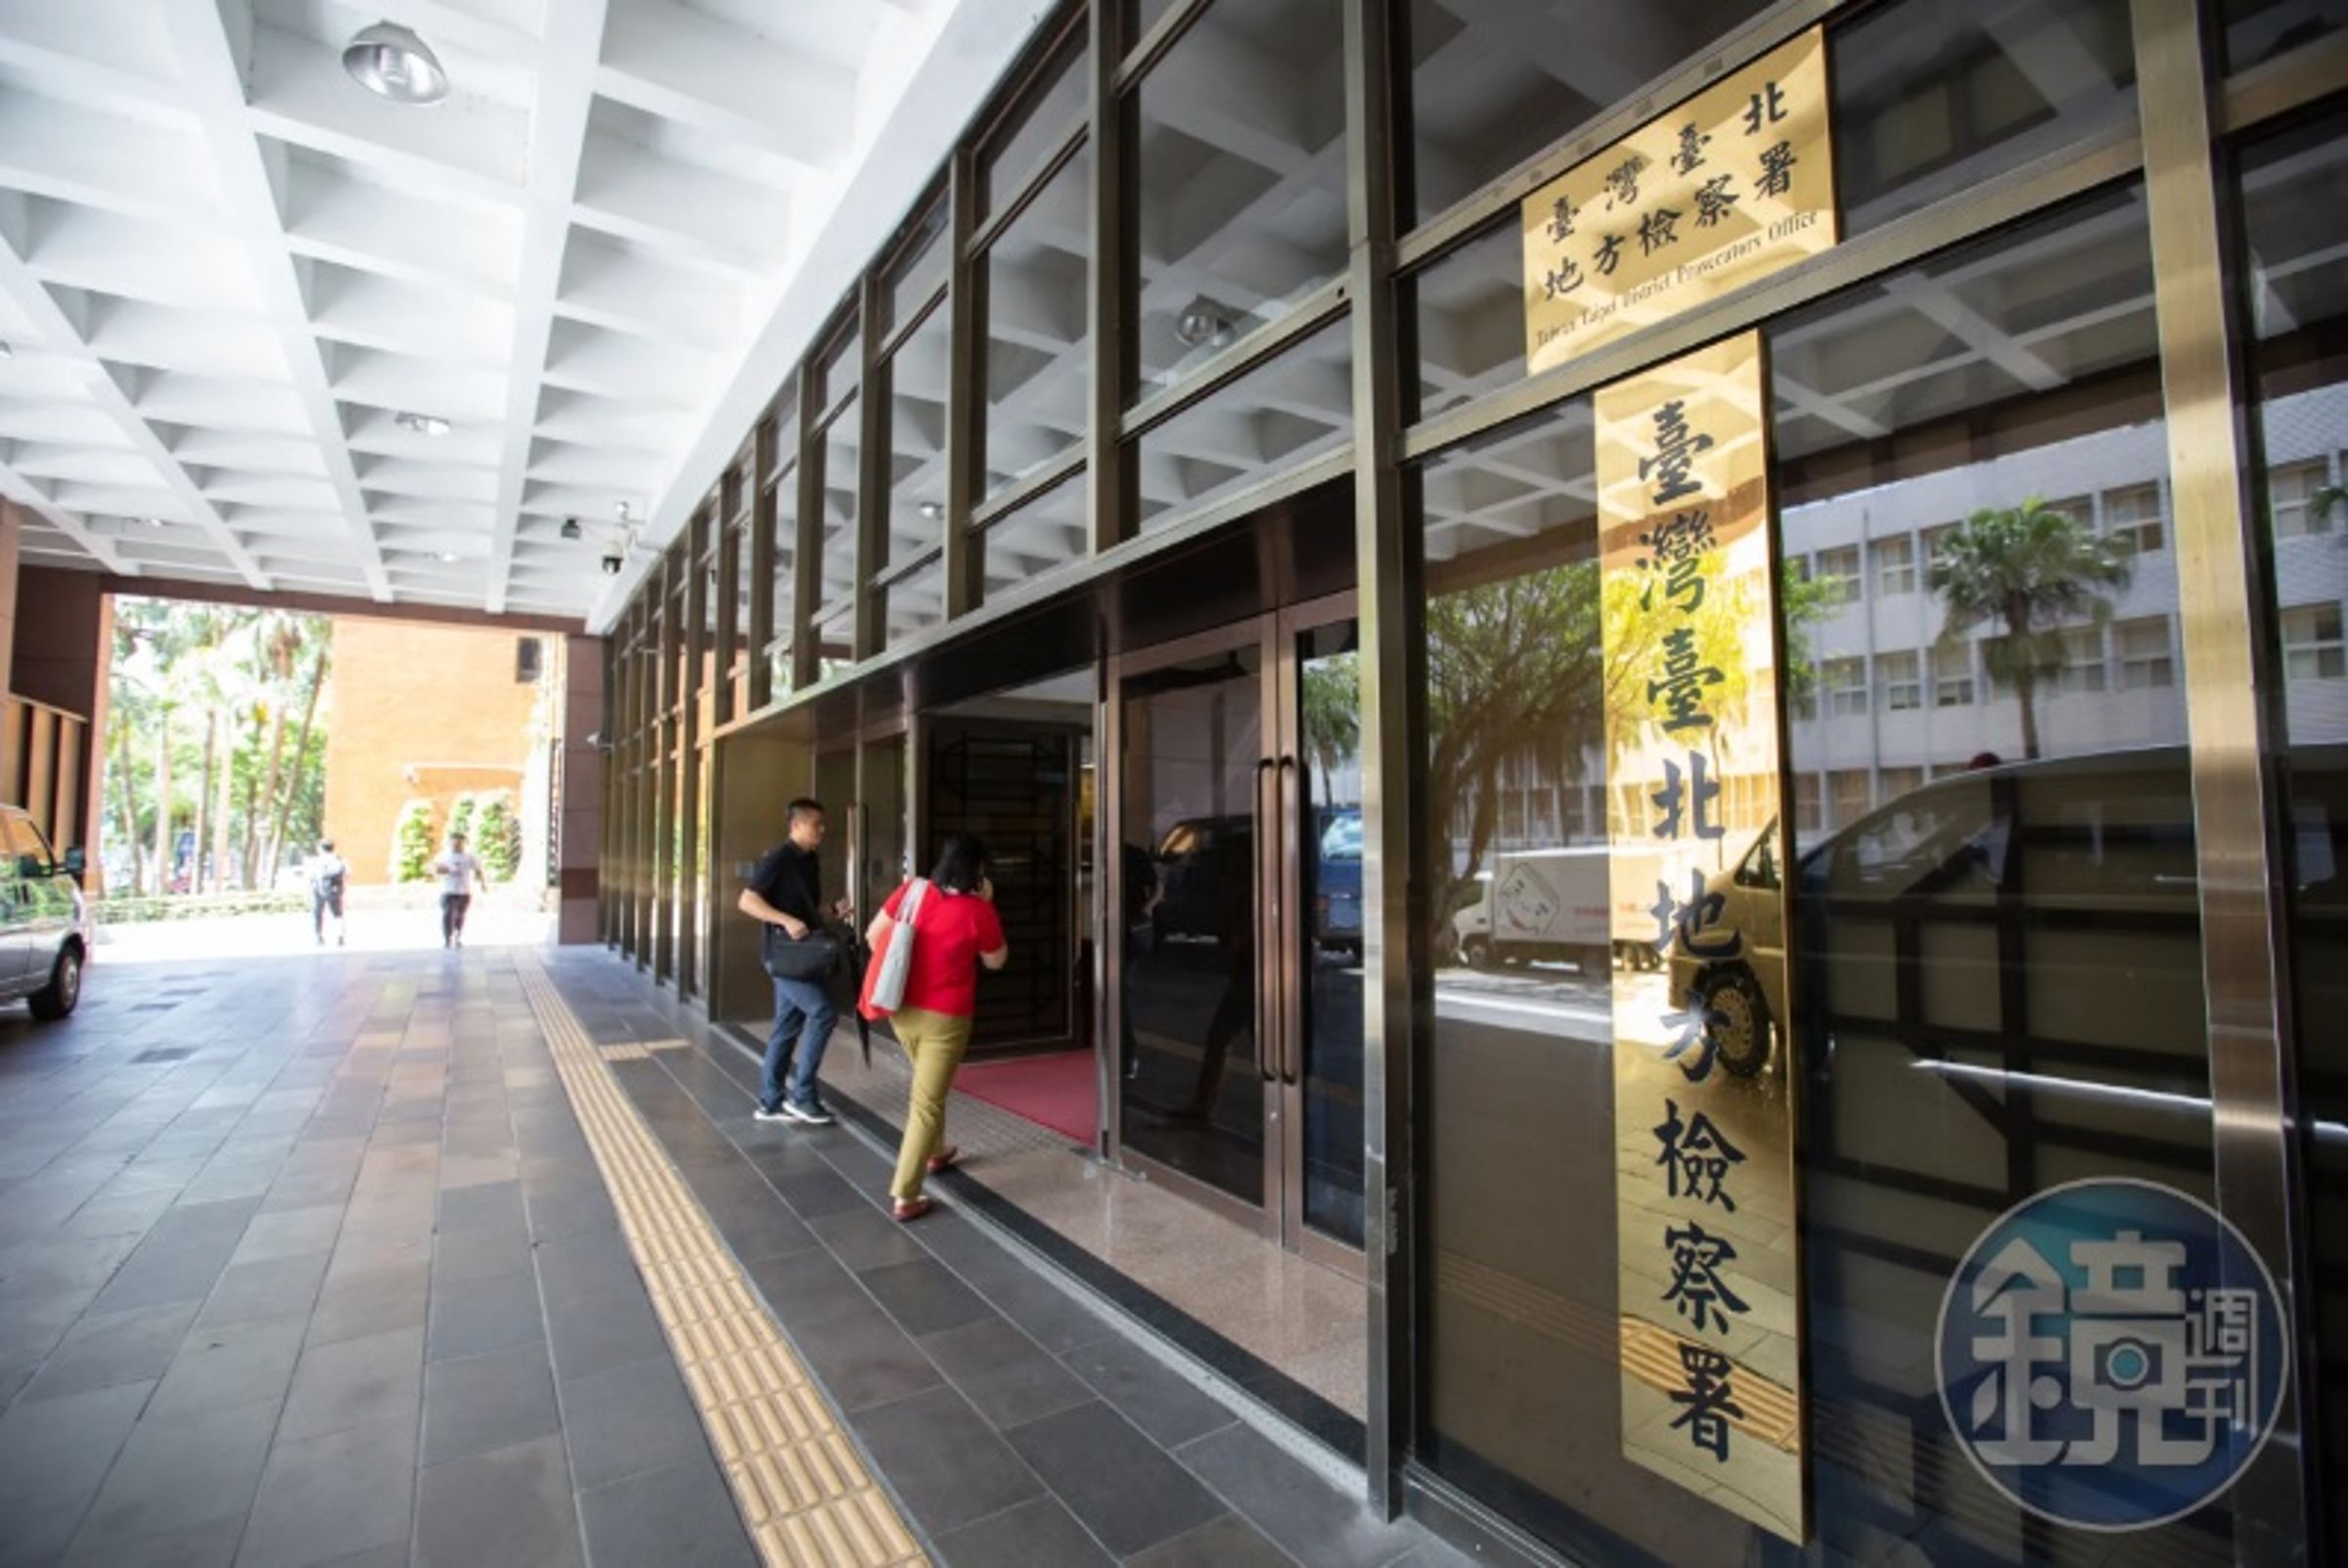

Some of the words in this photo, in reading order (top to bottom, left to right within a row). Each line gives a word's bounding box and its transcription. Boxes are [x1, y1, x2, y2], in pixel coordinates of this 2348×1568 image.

[1544, 141, 1798, 301] 地方檢察署
[1545, 82, 1788, 244] 臺灣臺北
[1768, 211, 1818, 242] Office
[1636, 400, 1751, 1463] 臺灣臺北地方檢察署
